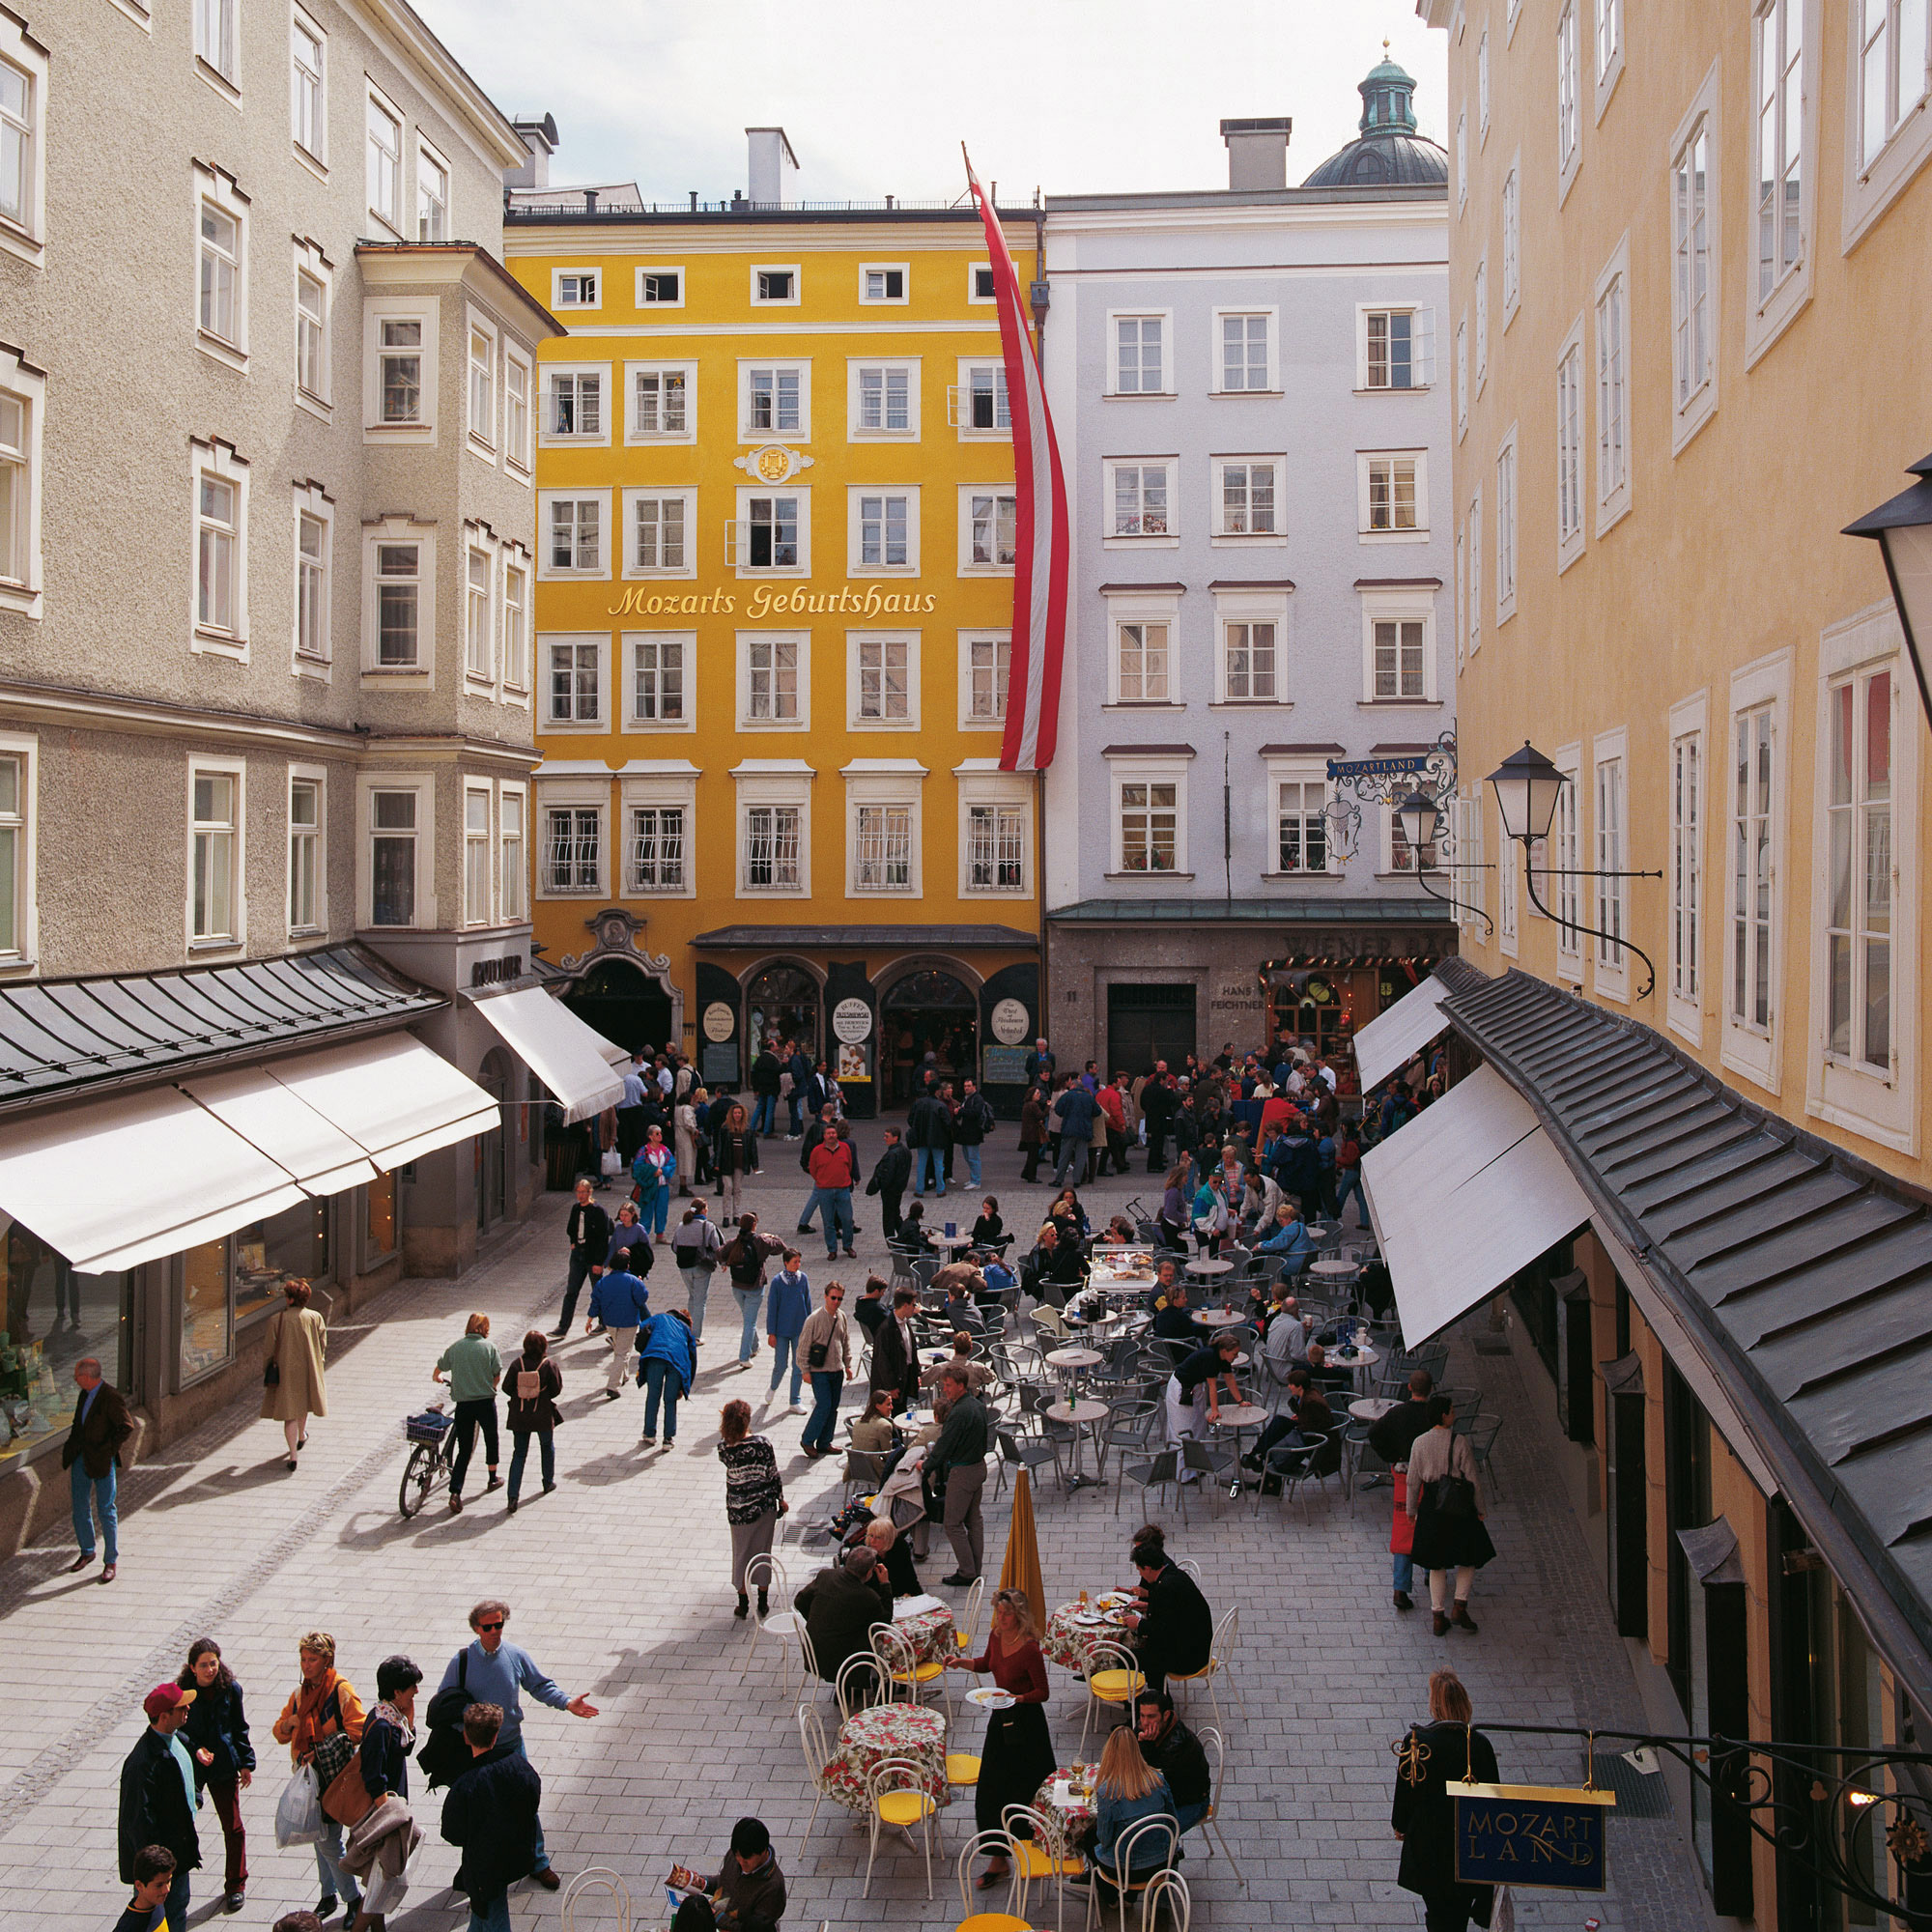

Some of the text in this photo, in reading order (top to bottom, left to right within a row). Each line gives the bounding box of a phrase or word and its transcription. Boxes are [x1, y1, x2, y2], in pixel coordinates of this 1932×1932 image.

[608, 584, 937, 619] Mozarts Geburtshaus
[1284, 937, 1391, 958] WIENER
[1066, 991, 1077, 1002] 11
[1222, 986, 1252, 996] HANS
[1210, 1001, 1264, 1010] FEICHTNER
[1468, 1811, 1593, 1840] MOZART
[1468, 1835, 1594, 1865] LAND
